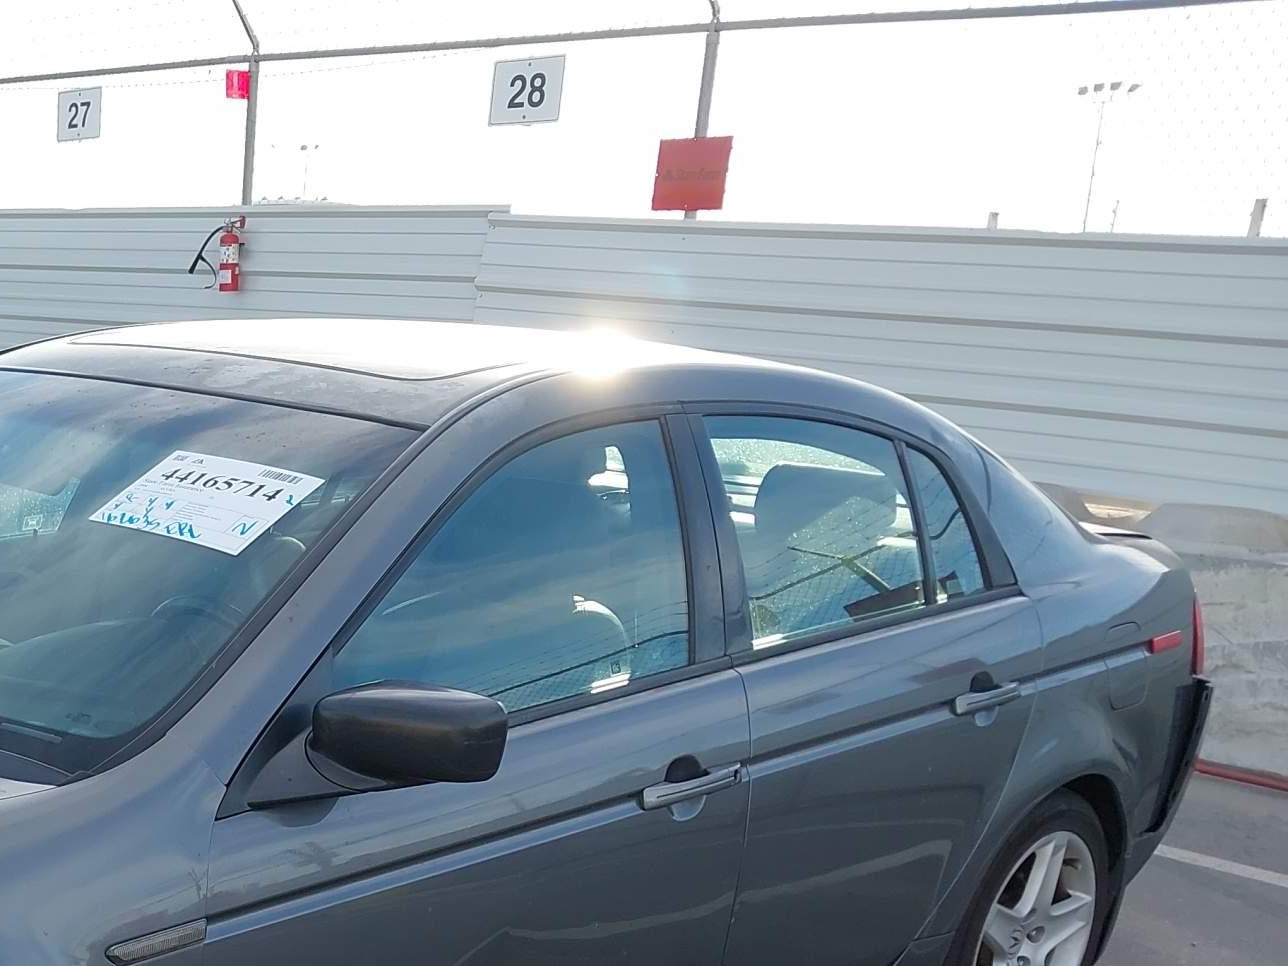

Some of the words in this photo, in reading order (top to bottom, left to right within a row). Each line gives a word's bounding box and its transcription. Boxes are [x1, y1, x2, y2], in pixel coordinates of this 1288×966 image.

[507, 73, 546, 109] 28
[68, 101, 91, 129] 27
[161, 468, 284, 501] 44165714
